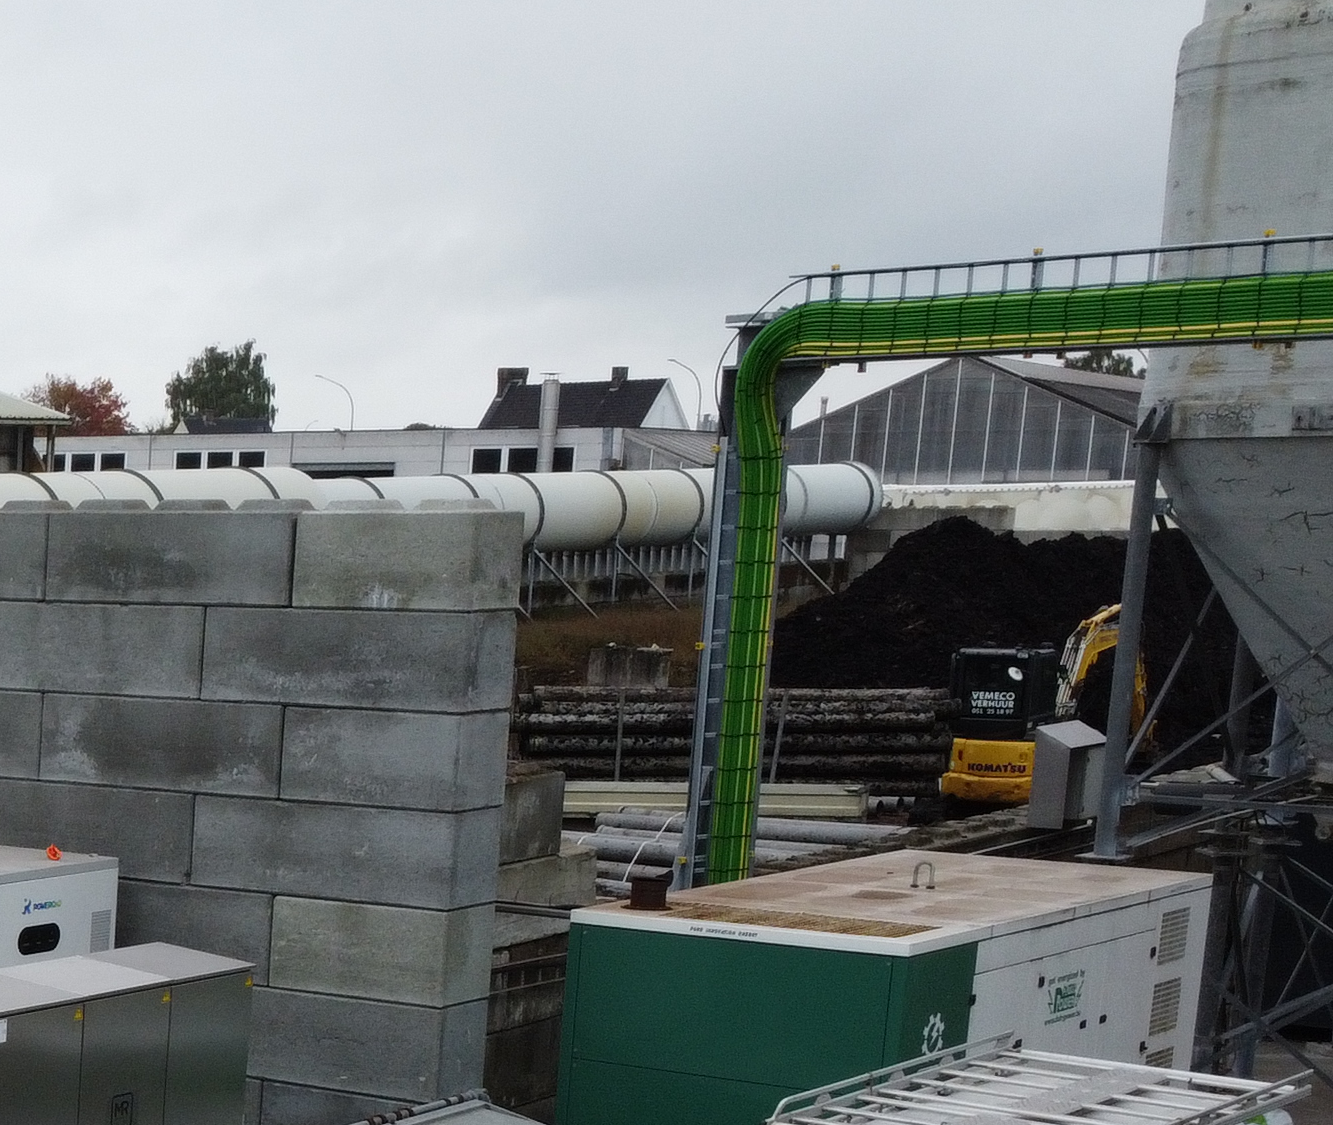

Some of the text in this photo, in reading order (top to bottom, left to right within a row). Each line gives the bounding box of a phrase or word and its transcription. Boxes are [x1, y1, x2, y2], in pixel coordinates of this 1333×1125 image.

[972, 691, 1015, 700] VEMECO
[971, 700, 1014, 708] VERHUUR
[968, 762, 1026, 773] KOMATSU
[114, 1101, 130, 1117] MR
